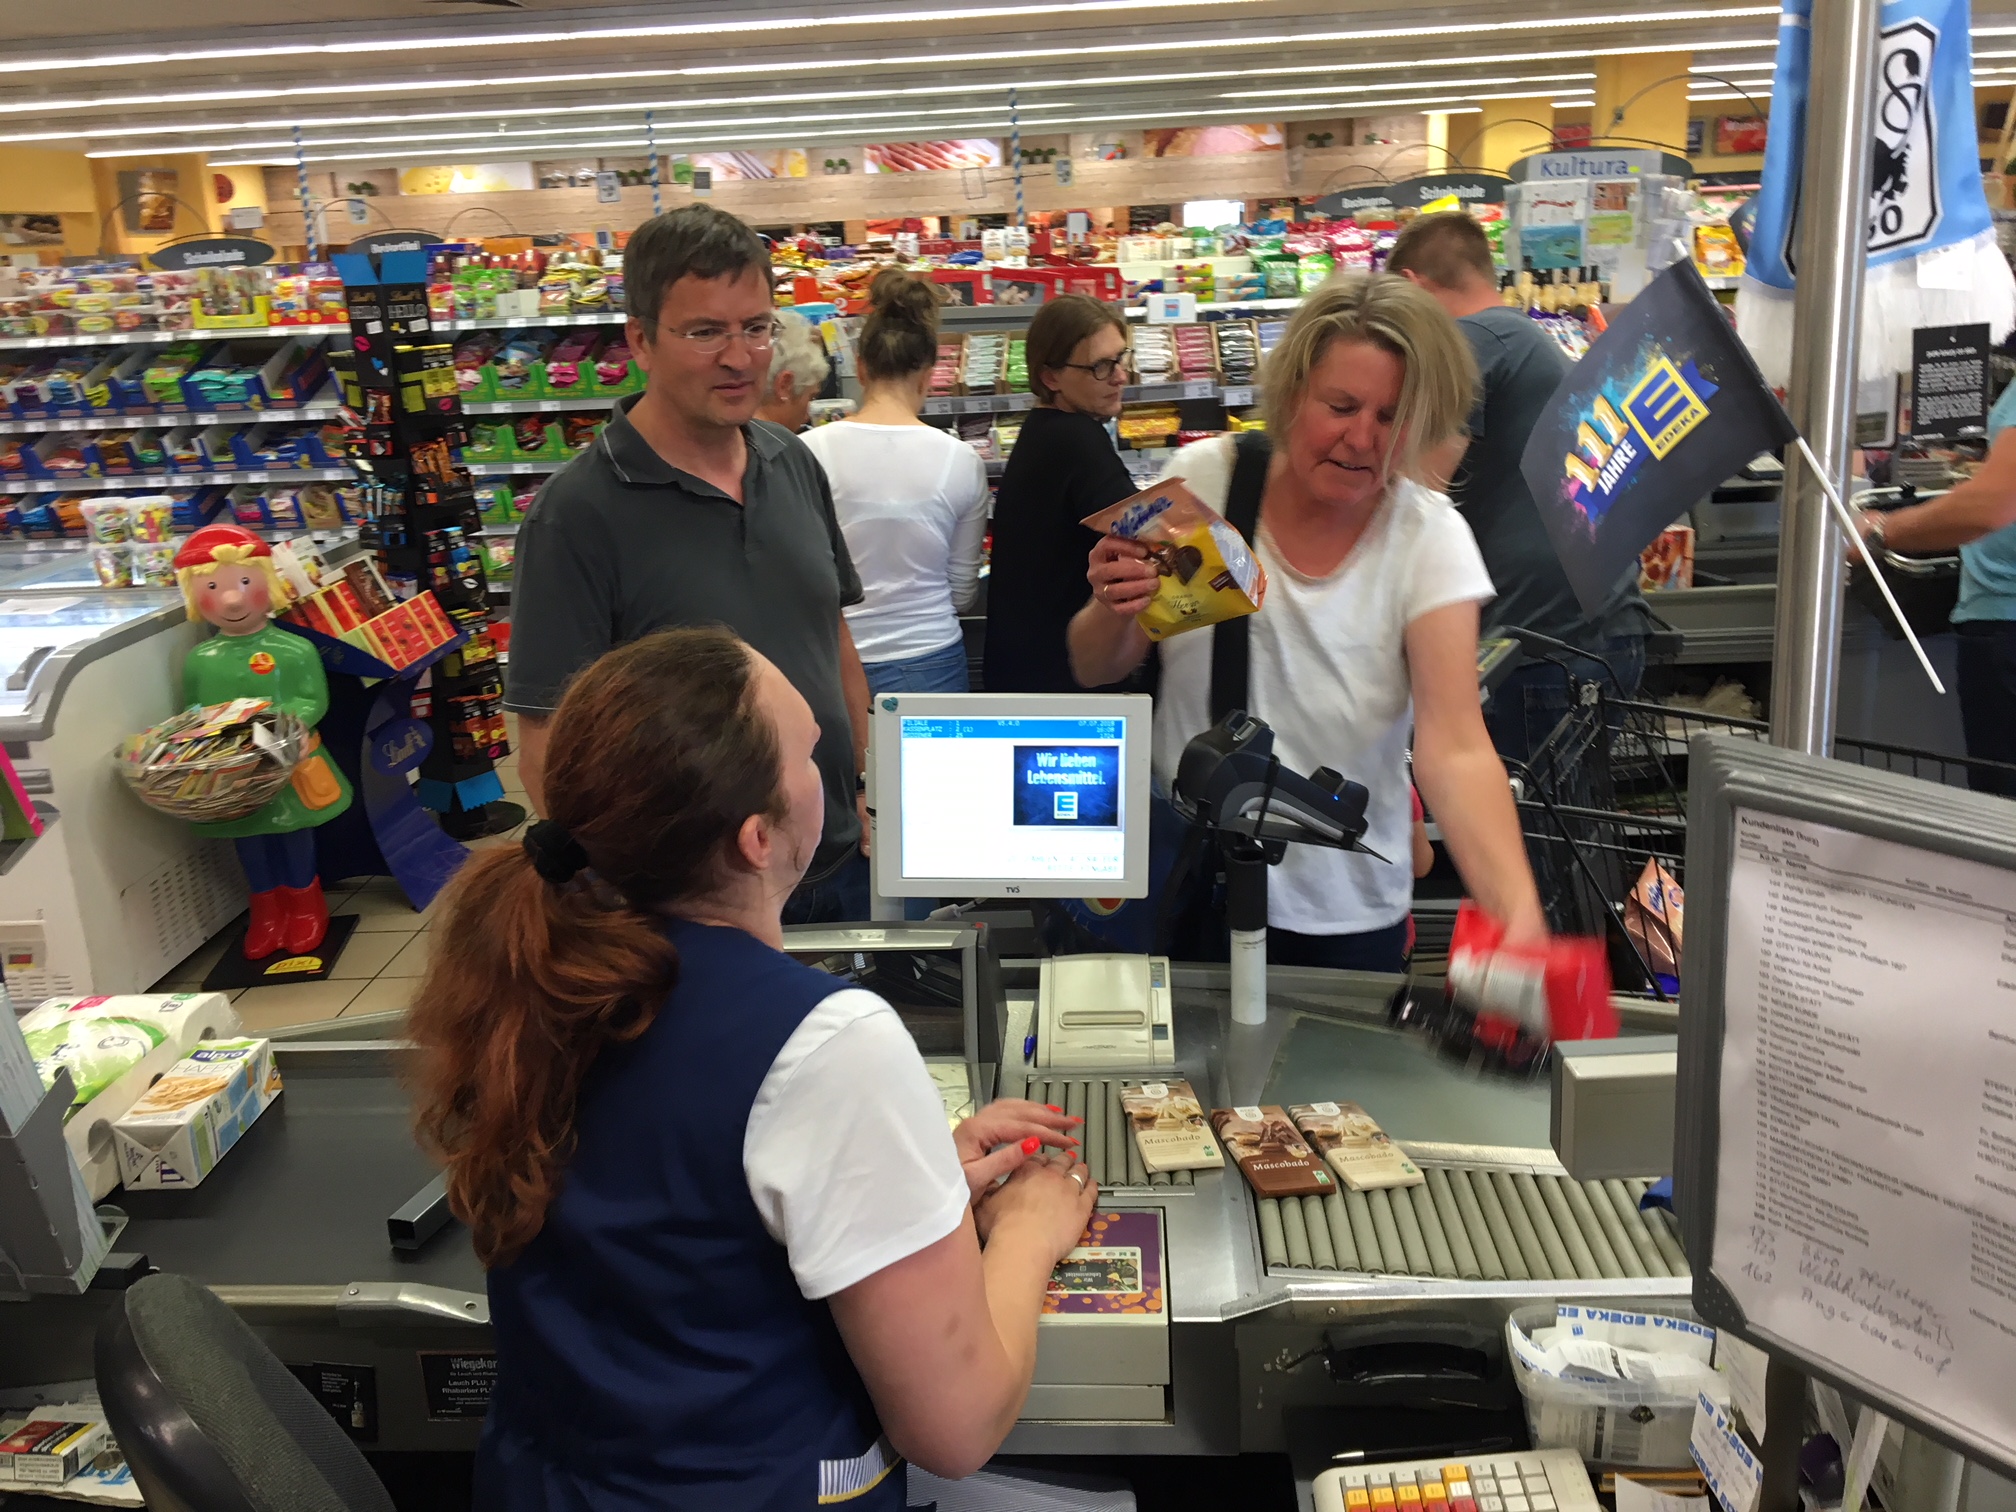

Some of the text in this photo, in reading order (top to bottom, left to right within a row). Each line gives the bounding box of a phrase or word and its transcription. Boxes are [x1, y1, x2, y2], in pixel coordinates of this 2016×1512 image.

[1655, 407, 1701, 451] EDEKA
[1597, 438, 1637, 496] JAHRE
[1036, 752, 1097, 768] Wir lieben
[1027, 769, 1106, 785] Lebensmittel.
[194, 1049, 247, 1062] alpro
[170, 1060, 243, 1074] HAFER
[1143, 1134, 1201, 1146] Mascobado
[1338, 1151, 1395, 1163] Mascobado
[1252, 1159, 1310, 1171] Mascobado
[1586, 1309, 1647, 1326] EDEKA
[1653, 1317, 1716, 1340] EDEKA
[442, 1387, 479, 1395] Rhabarber
